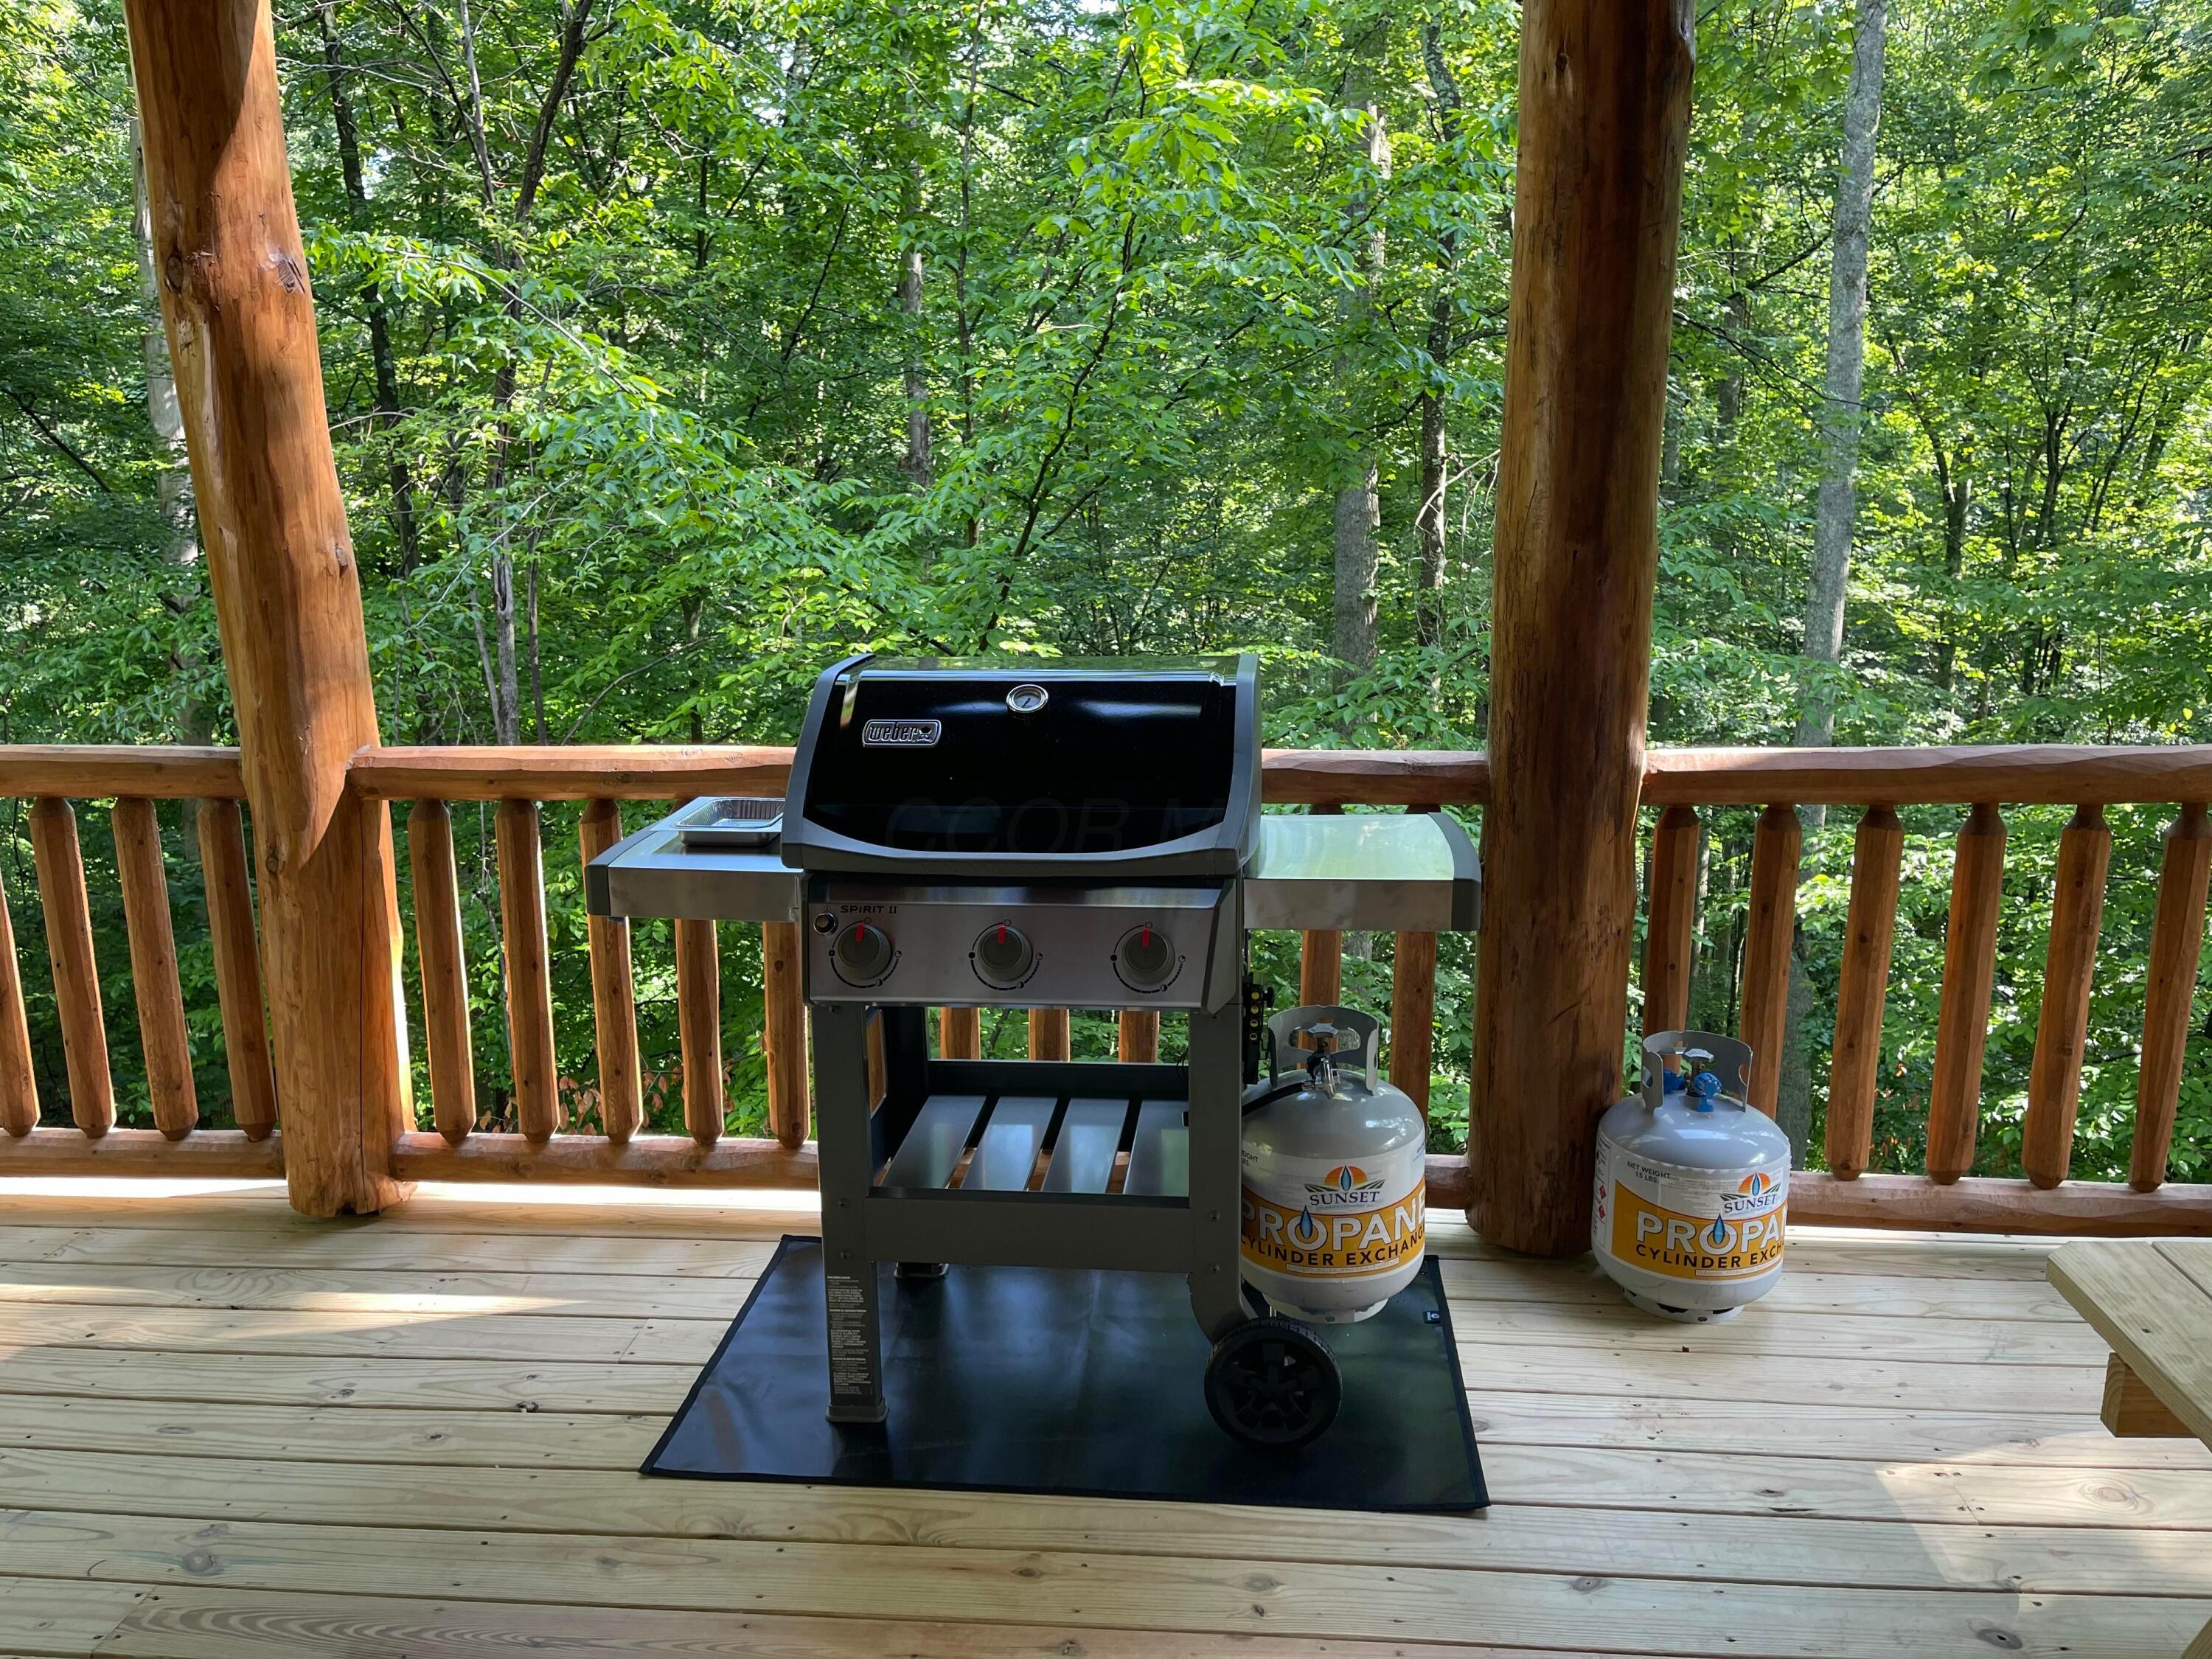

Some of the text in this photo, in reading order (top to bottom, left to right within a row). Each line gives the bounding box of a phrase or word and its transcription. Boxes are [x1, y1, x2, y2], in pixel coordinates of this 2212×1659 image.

[868, 722, 919, 742] weber
[841, 905, 885, 914] SPIRIT
[1241, 1150, 1258, 1163] EIGHT
[1627, 1161, 1672, 1180] NET WEIGHT
[1635, 1171, 1644, 1179] 15
[1310, 1191, 1380, 1206] SUNSET
[1724, 1194, 1778, 1214] SUNSET
[1346, 1220, 1425, 1266] EXCHANG
[1636, 1244, 1741, 1268] CYLINDER
